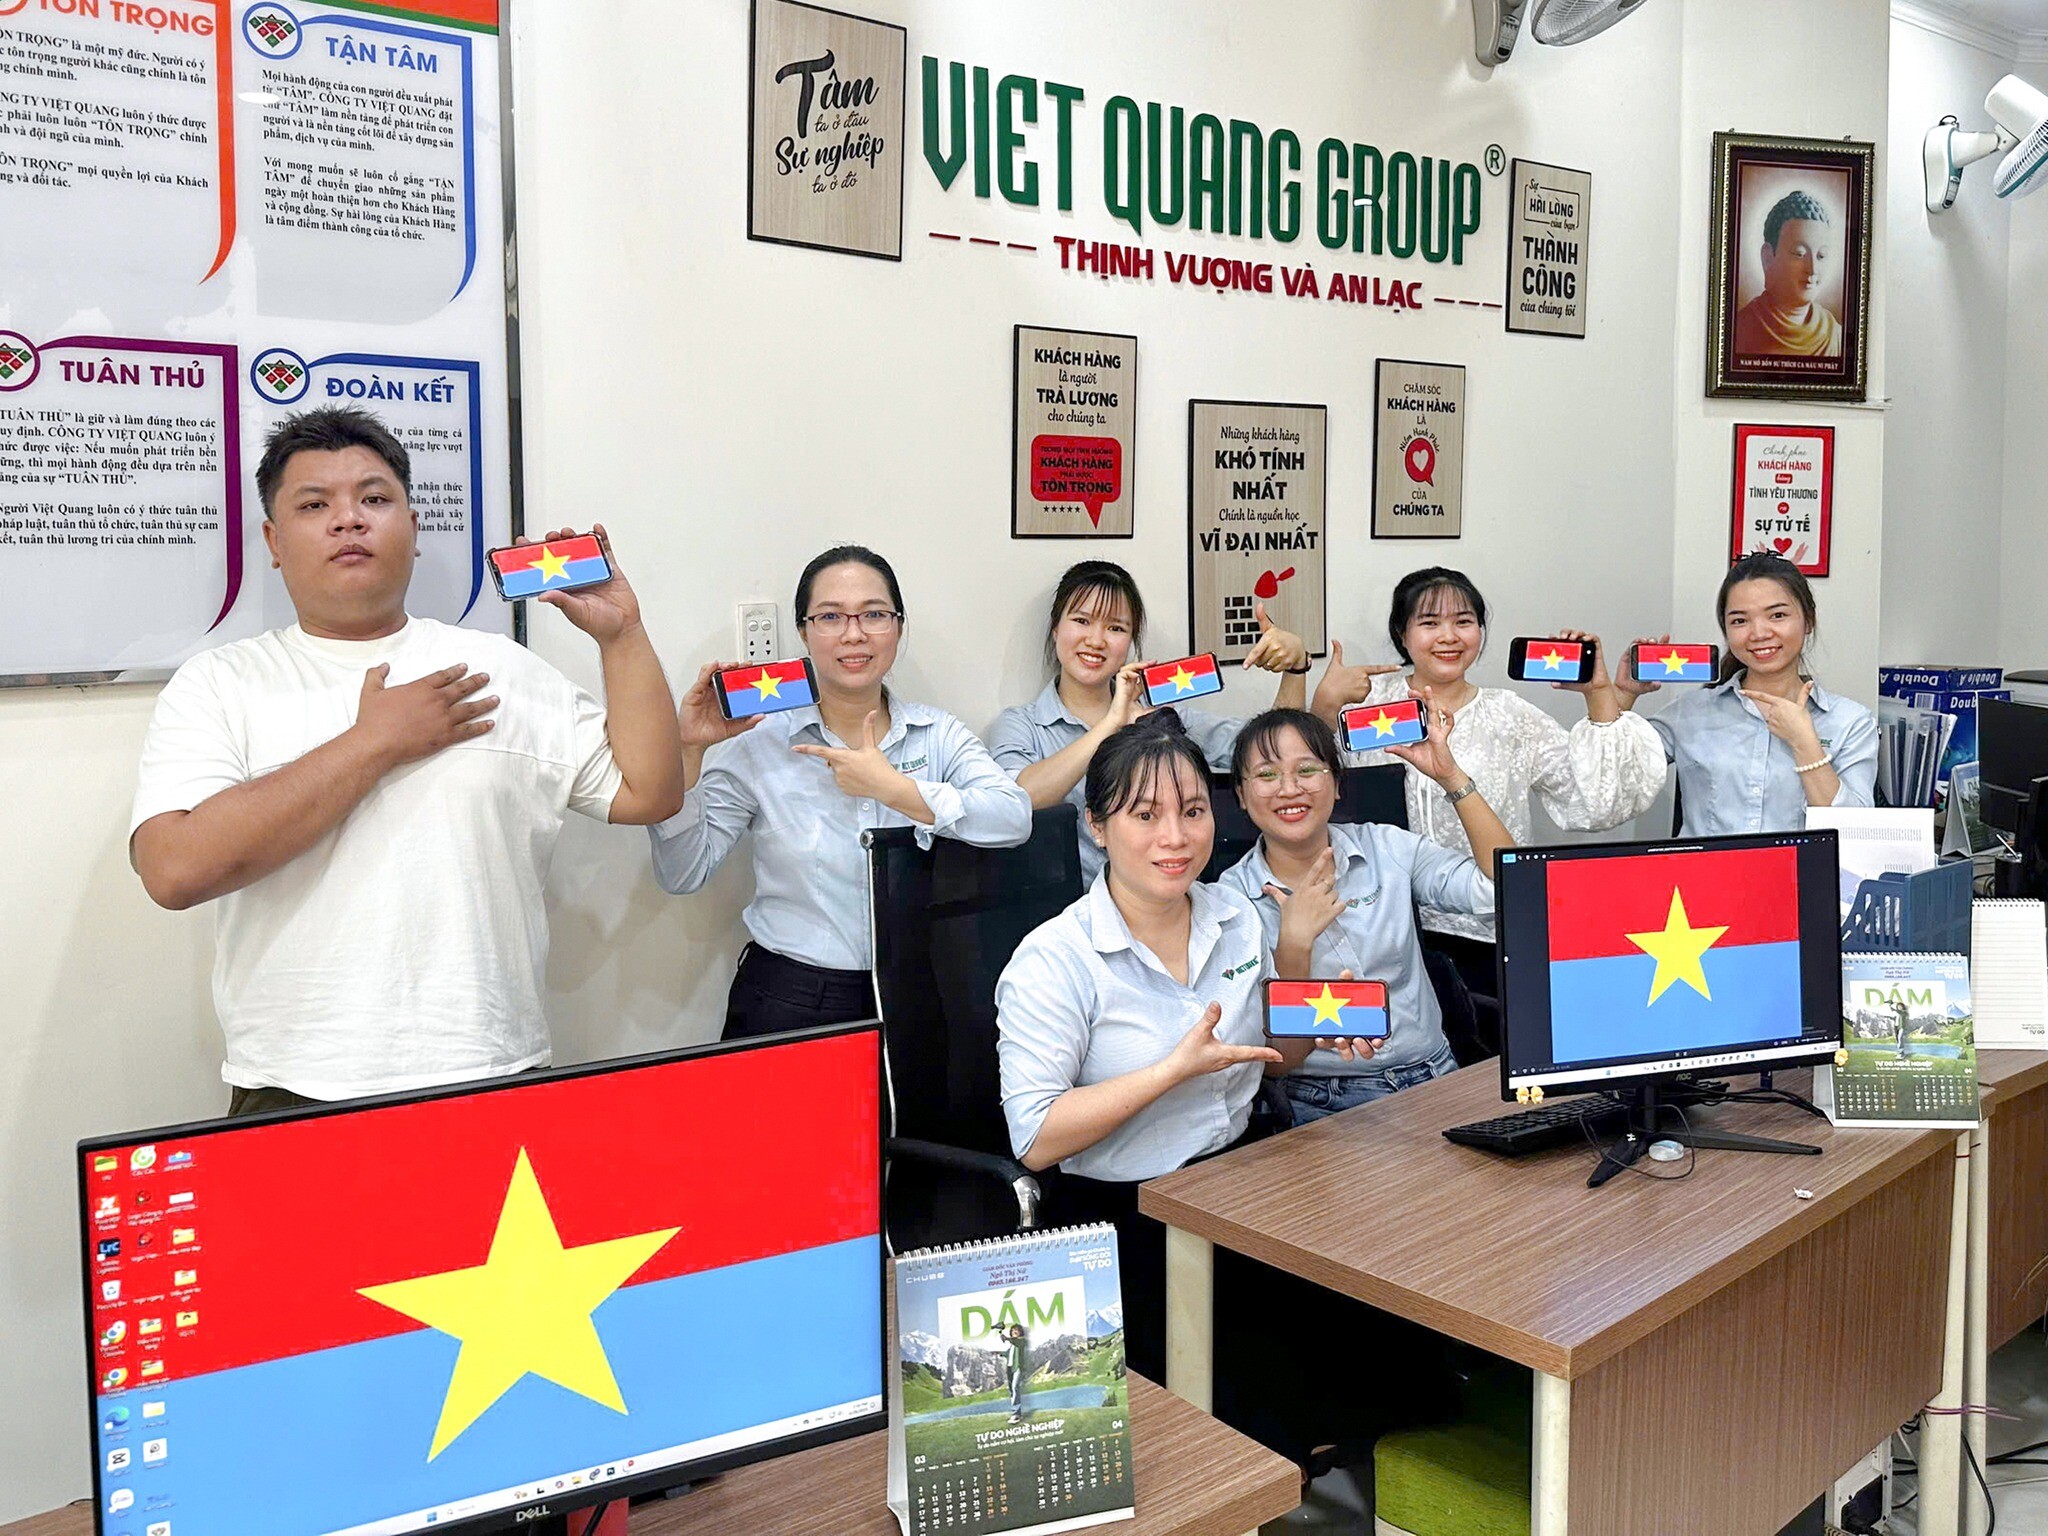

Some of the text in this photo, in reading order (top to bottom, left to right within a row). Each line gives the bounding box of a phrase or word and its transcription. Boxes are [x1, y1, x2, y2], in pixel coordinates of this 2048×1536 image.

[110, 1, 214, 36] TRỌNG
[16, 31, 197, 68] TRỌNG” là một mỹ đức. Người có
[325, 35, 437, 73] TẬN TÂM
[262, 69, 452, 107] Mọi hành động của con người đều xuất phát
[775, 49, 879, 138] Tâm
[814, 115, 828, 133] ta
[775, 132, 884, 177] Sự nghiệp
[922, 55, 1482, 265] VIET QUANG GROUP
[812, 175, 826, 193] ta
[1530, 194, 1573, 217] HÀI LÒNG
[1522, 231, 1578, 265] THÀNH
[1053, 235, 1423, 313] THỊNH VƯỢNG VÀ AN LẠC
[1522, 264, 1576, 300] CÔNG
[1520, 299, 1576, 318] của chúng tôi
[1035, 347, 1121, 369] KHÁCH HÀNG
[59, 357, 205, 389] TUÂN THỦ
[1059, 369, 1097, 387] là người
[326, 374, 455, 403] ĐOÀN KẾT
[1036, 385, 1118, 408] TRẢ LƯƠNG
[1404, 383, 1441, 395] CHĂM SÓC
[1387, 396, 1456, 413] KHÁCH HÀNG
[0, 407, 216, 428] TUÂN THỦ” là giữ và làm đúng theo các
[1048, 408, 1106, 427] cho chúng ta
[1417, 413, 1426, 424] LÀ
[1221, 427, 1300, 444] Những khách hàng
[1041, 455, 1113, 469] KHÁCH HÀNG
[1215, 446, 1305, 470] KHÓ TÍNH
[1758, 459, 1812, 471] KHÁCH HÀNG
[1041, 477, 1113, 497] TÔN TRỌNG
[1233, 472, 1287, 500] NHẤT
[1412, 488, 1427, 500] CỦA
[1749, 487, 1818, 499] TÌNH YÊU THƯƠNG
[32, 503, 217, 516] Việt Quang luôn có thức tuân thủ
[1219, 507, 1300, 525] Chính là nguồn học
[1393, 501, 1444, 516] CHÚNG TA
[1755, 514, 1810, 535] SỰ TỬ TẾ
[1200, 523, 1319, 557] VĨ ĐẠI NHẤT
[1893, 673, 1939, 686] Double
[1968, 673, 1996, 684] Double
[1950, 697, 1976, 709] Doub
[1864, 982, 1933, 1008] DÁM
[1097, 1259, 1112, 1268] DO
[961, 1289, 1065, 1343] DÁM
[975, 1418, 1064, 1443] TỰ DO NGHỀ NGHIỆP
[1112, 1419, 1123, 1430] 04
[914, 1455, 926, 1465] 03
[517, 1506, 550, 1522] DELL
